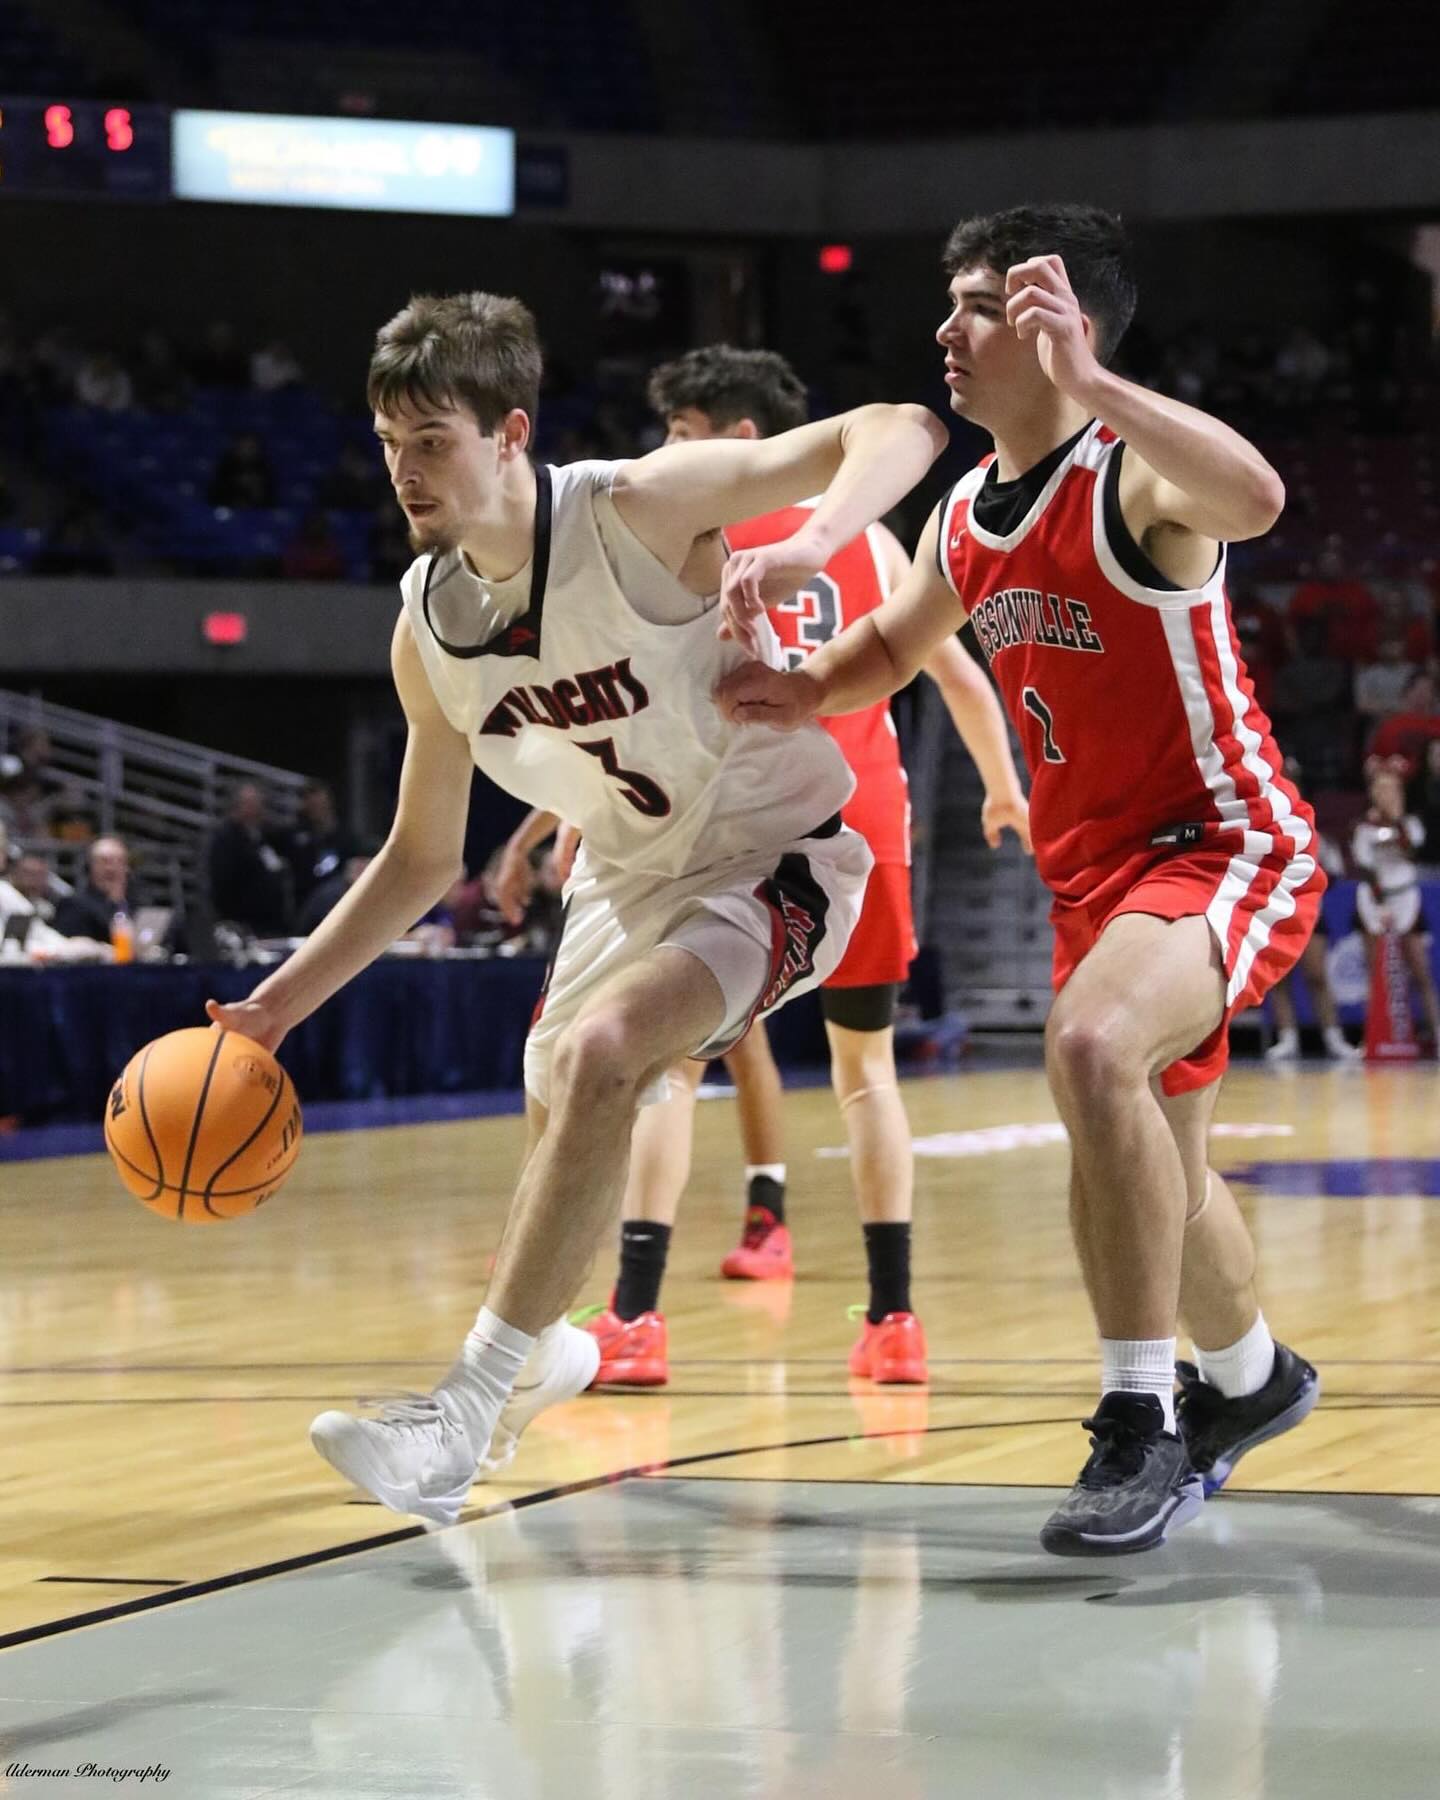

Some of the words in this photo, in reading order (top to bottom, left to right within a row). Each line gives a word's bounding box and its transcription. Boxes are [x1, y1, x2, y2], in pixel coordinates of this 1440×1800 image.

[479, 657, 649, 738] WILDCATS
[1022, 686, 1067, 764] 1
[570, 736, 671, 817] 3
[1184, 828, 1196, 840] M
